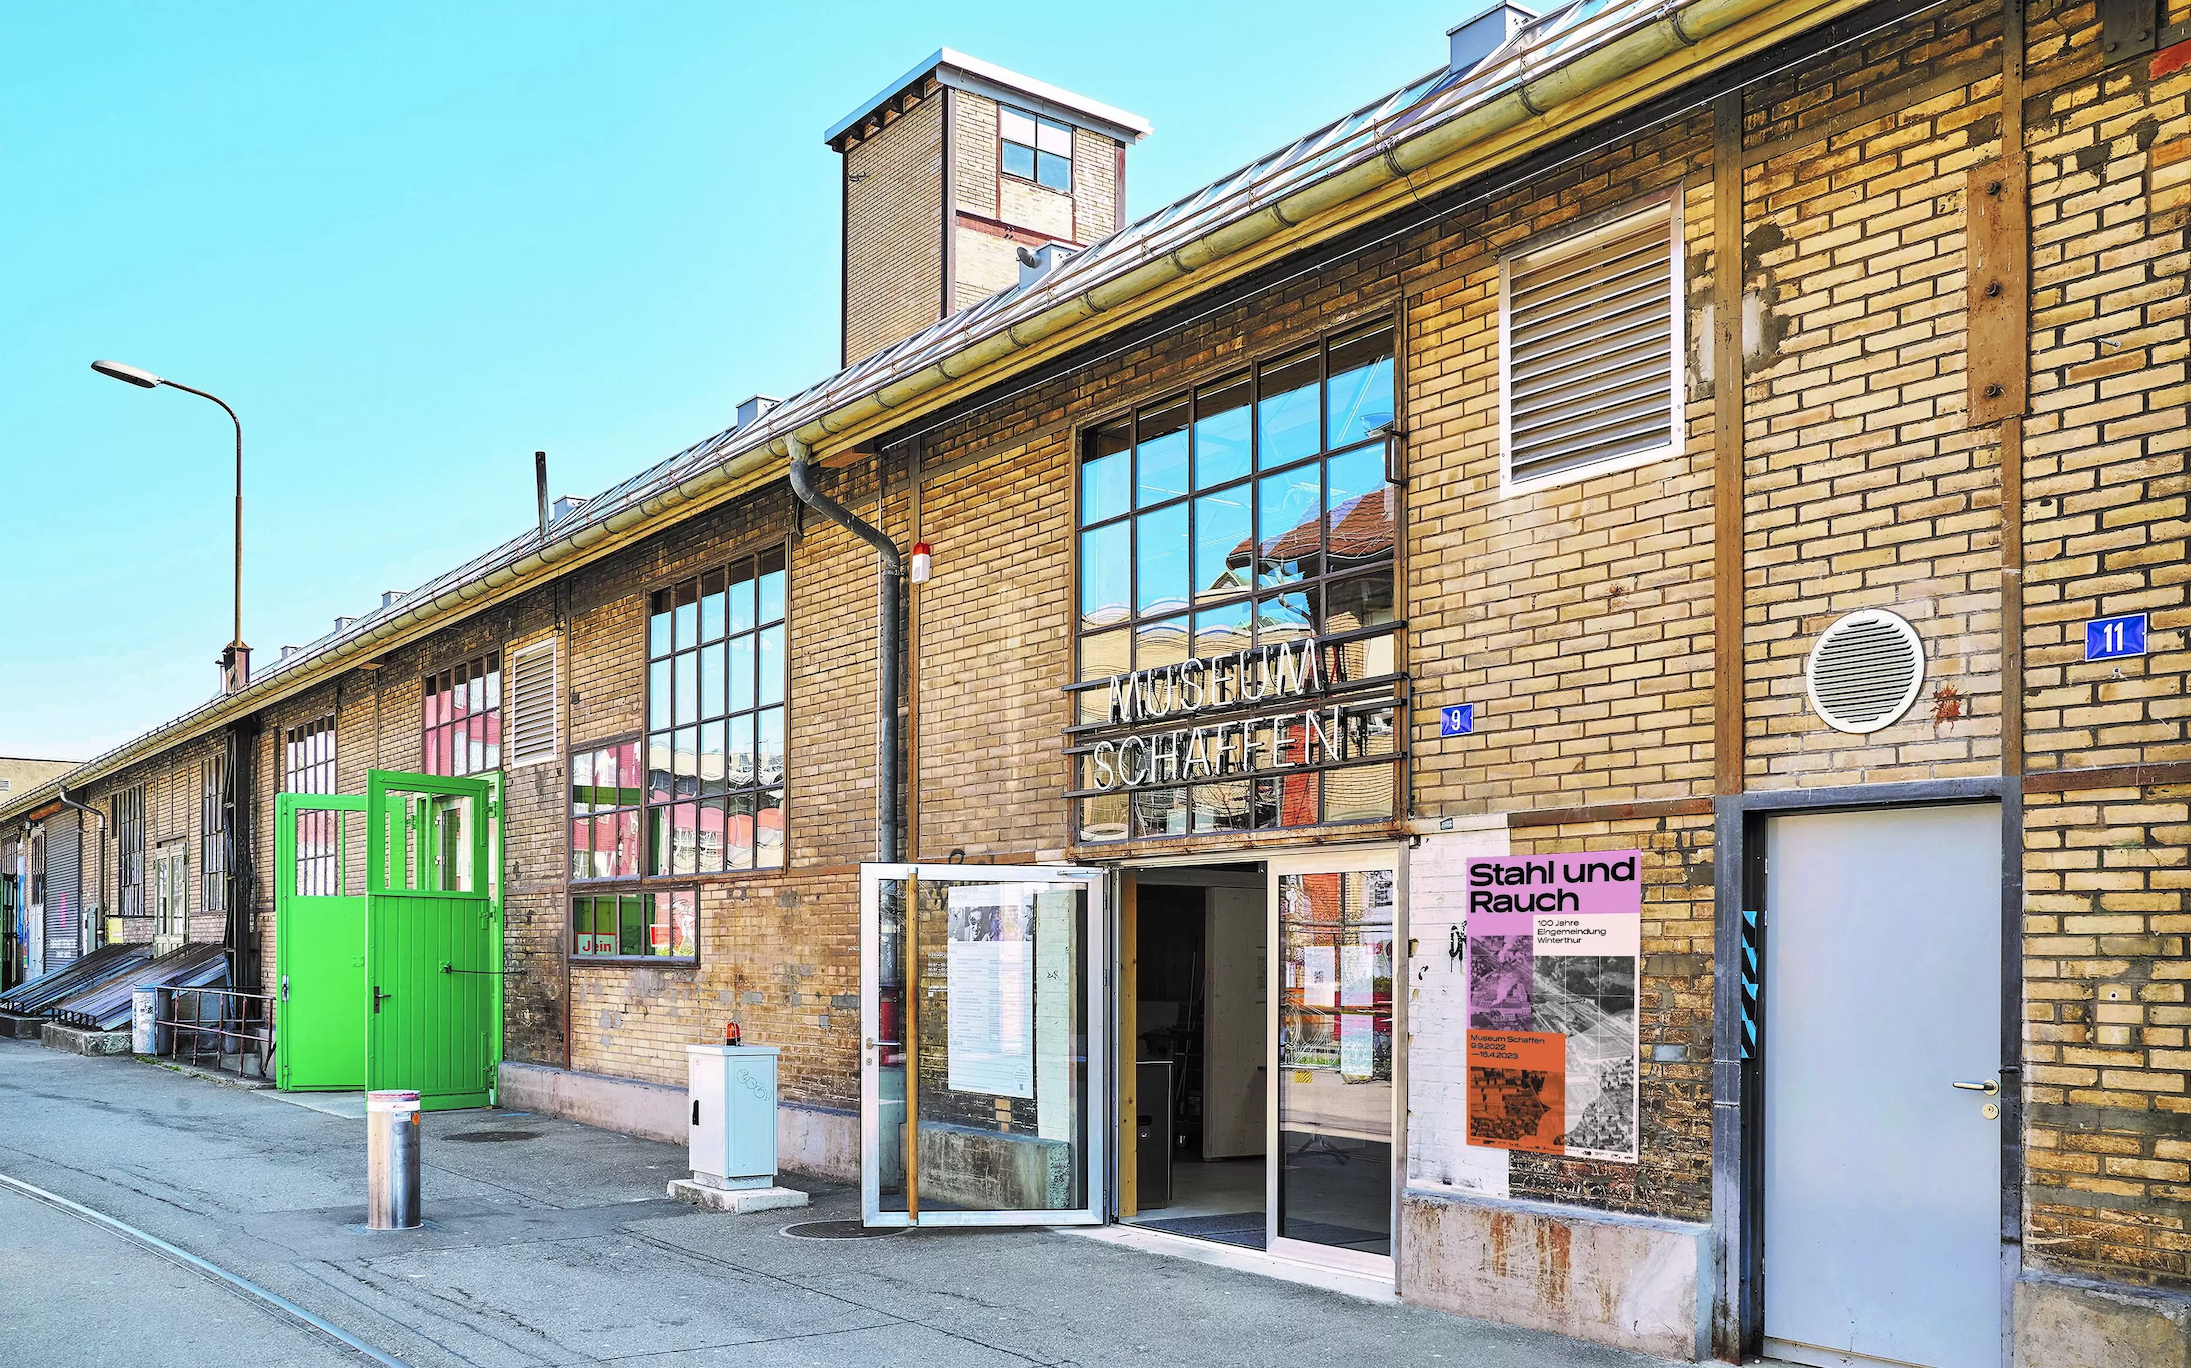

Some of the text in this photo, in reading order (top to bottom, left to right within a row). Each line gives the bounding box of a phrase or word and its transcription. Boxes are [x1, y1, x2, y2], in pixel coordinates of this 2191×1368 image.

[2103, 621, 2124, 653] 11
[1107, 638, 1321, 724] MUSEUM
[1451, 709, 1461, 731] 9
[1093, 705, 1341, 791] SCHAFFEN
[1470, 856, 1636, 887] Stahl und
[1470, 888, 1580, 913] Rauch
[1537, 919, 1580, 927] 100 Jahre
[1537, 928, 1607, 937] Eingemeindung
[1537, 936, 1582, 944] Winterthur
[1470, 1034, 1546, 1044] Museum Schaffen
[1470, 1042, 1506, 1051] 9.9.2022
